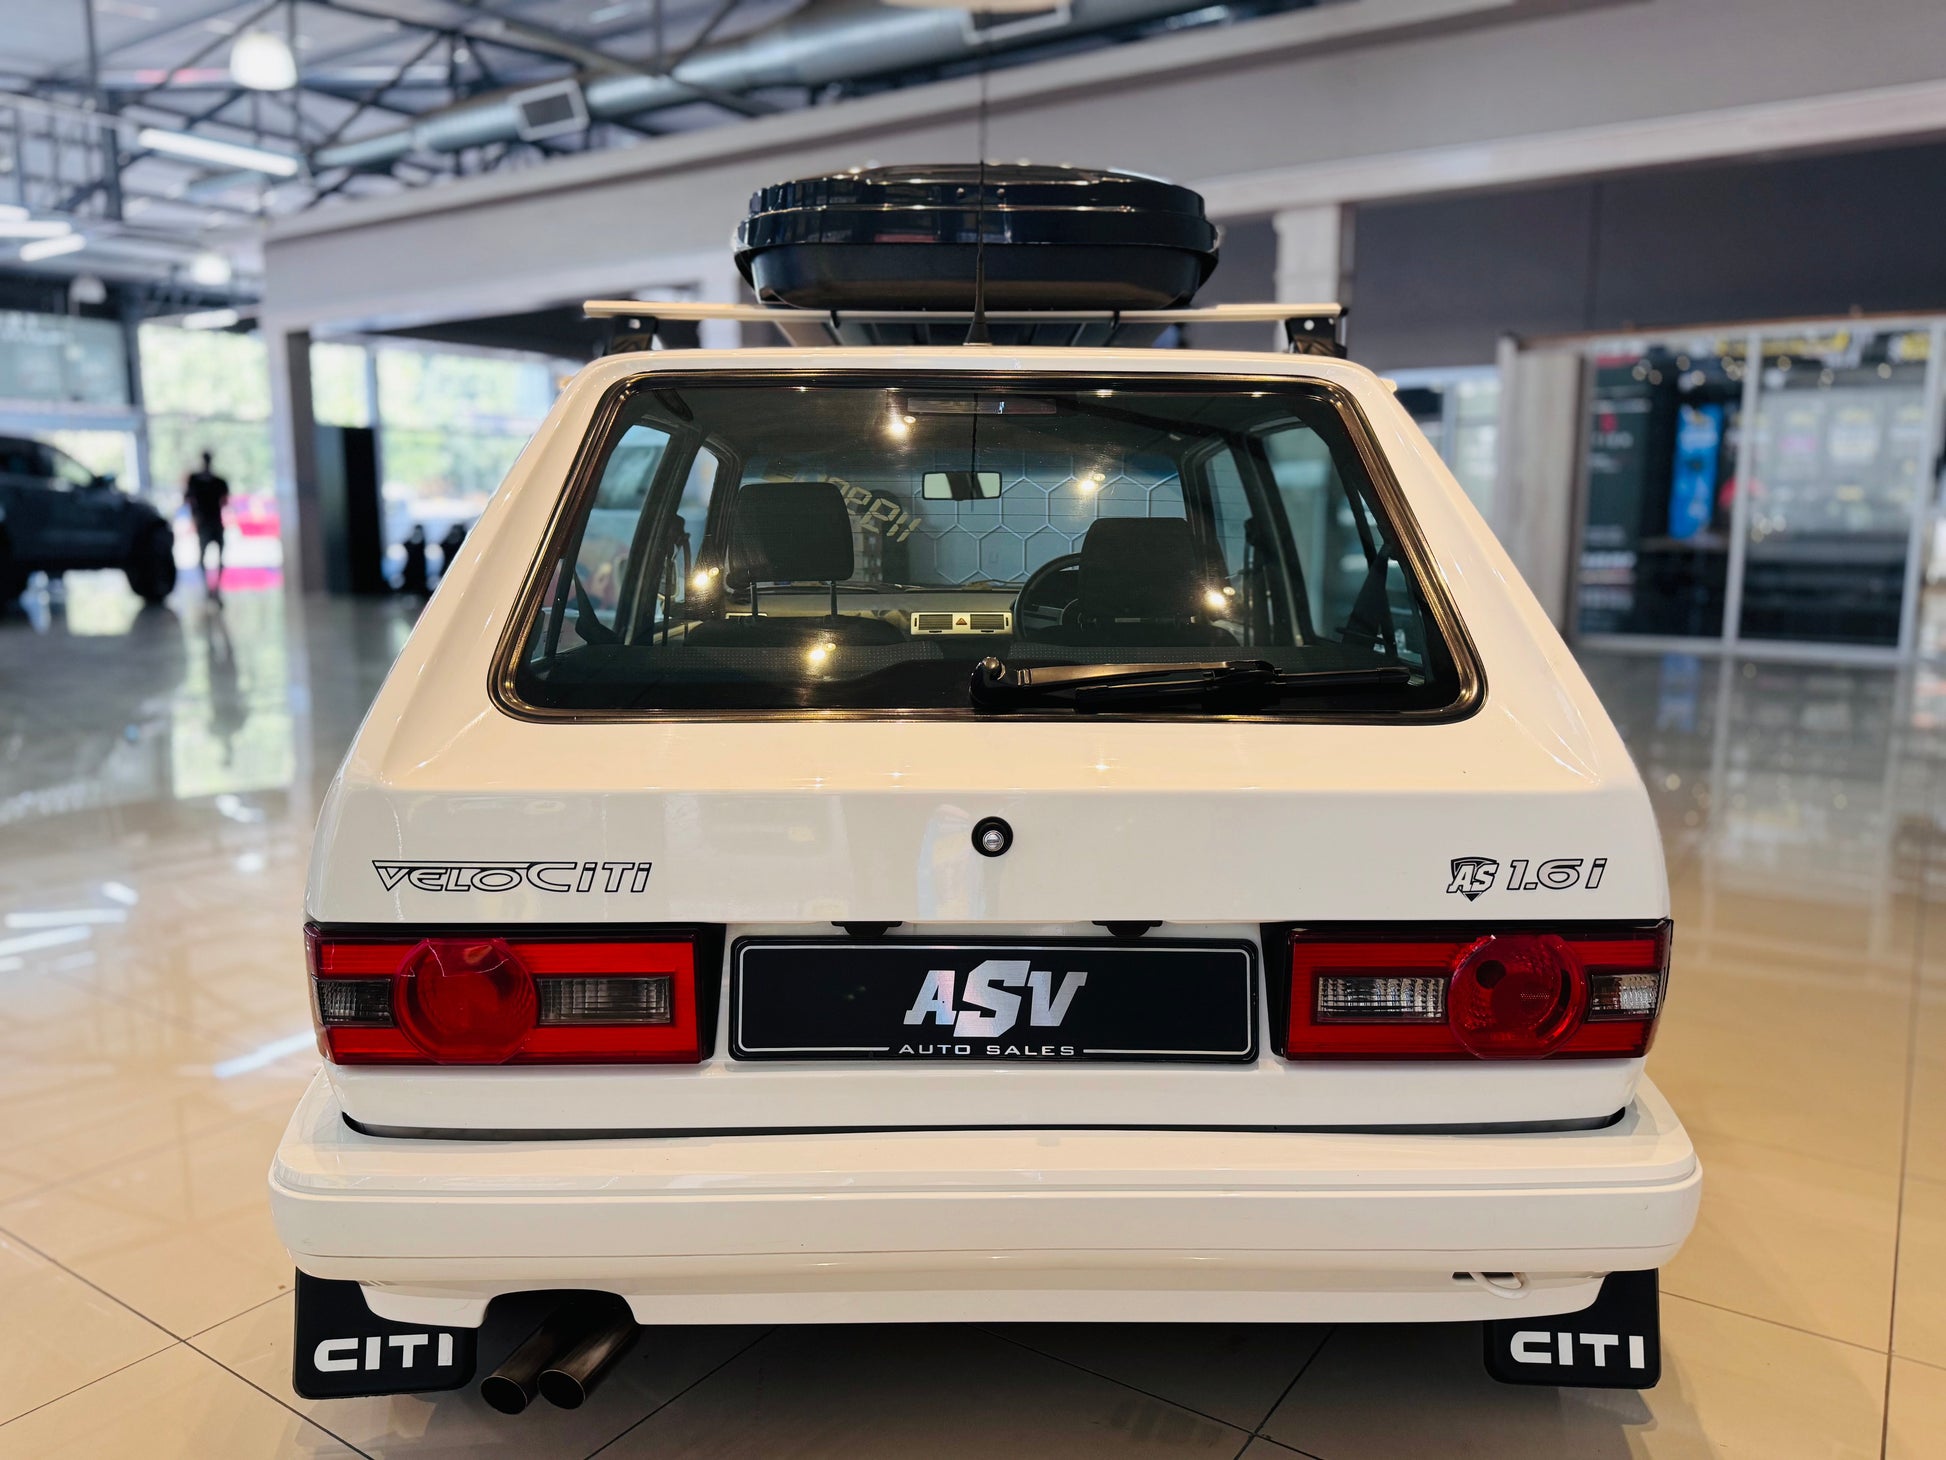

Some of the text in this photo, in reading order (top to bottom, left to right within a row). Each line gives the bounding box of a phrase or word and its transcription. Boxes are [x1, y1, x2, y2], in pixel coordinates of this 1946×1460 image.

[1446, 862, 1499, 893] AS
[903, 960, 1088, 1037] ASV
[899, 1045, 1075, 1056] AUTO SALES
[314, 1333, 453, 1372] CITI
[1510, 1331, 1645, 1369] CITI
